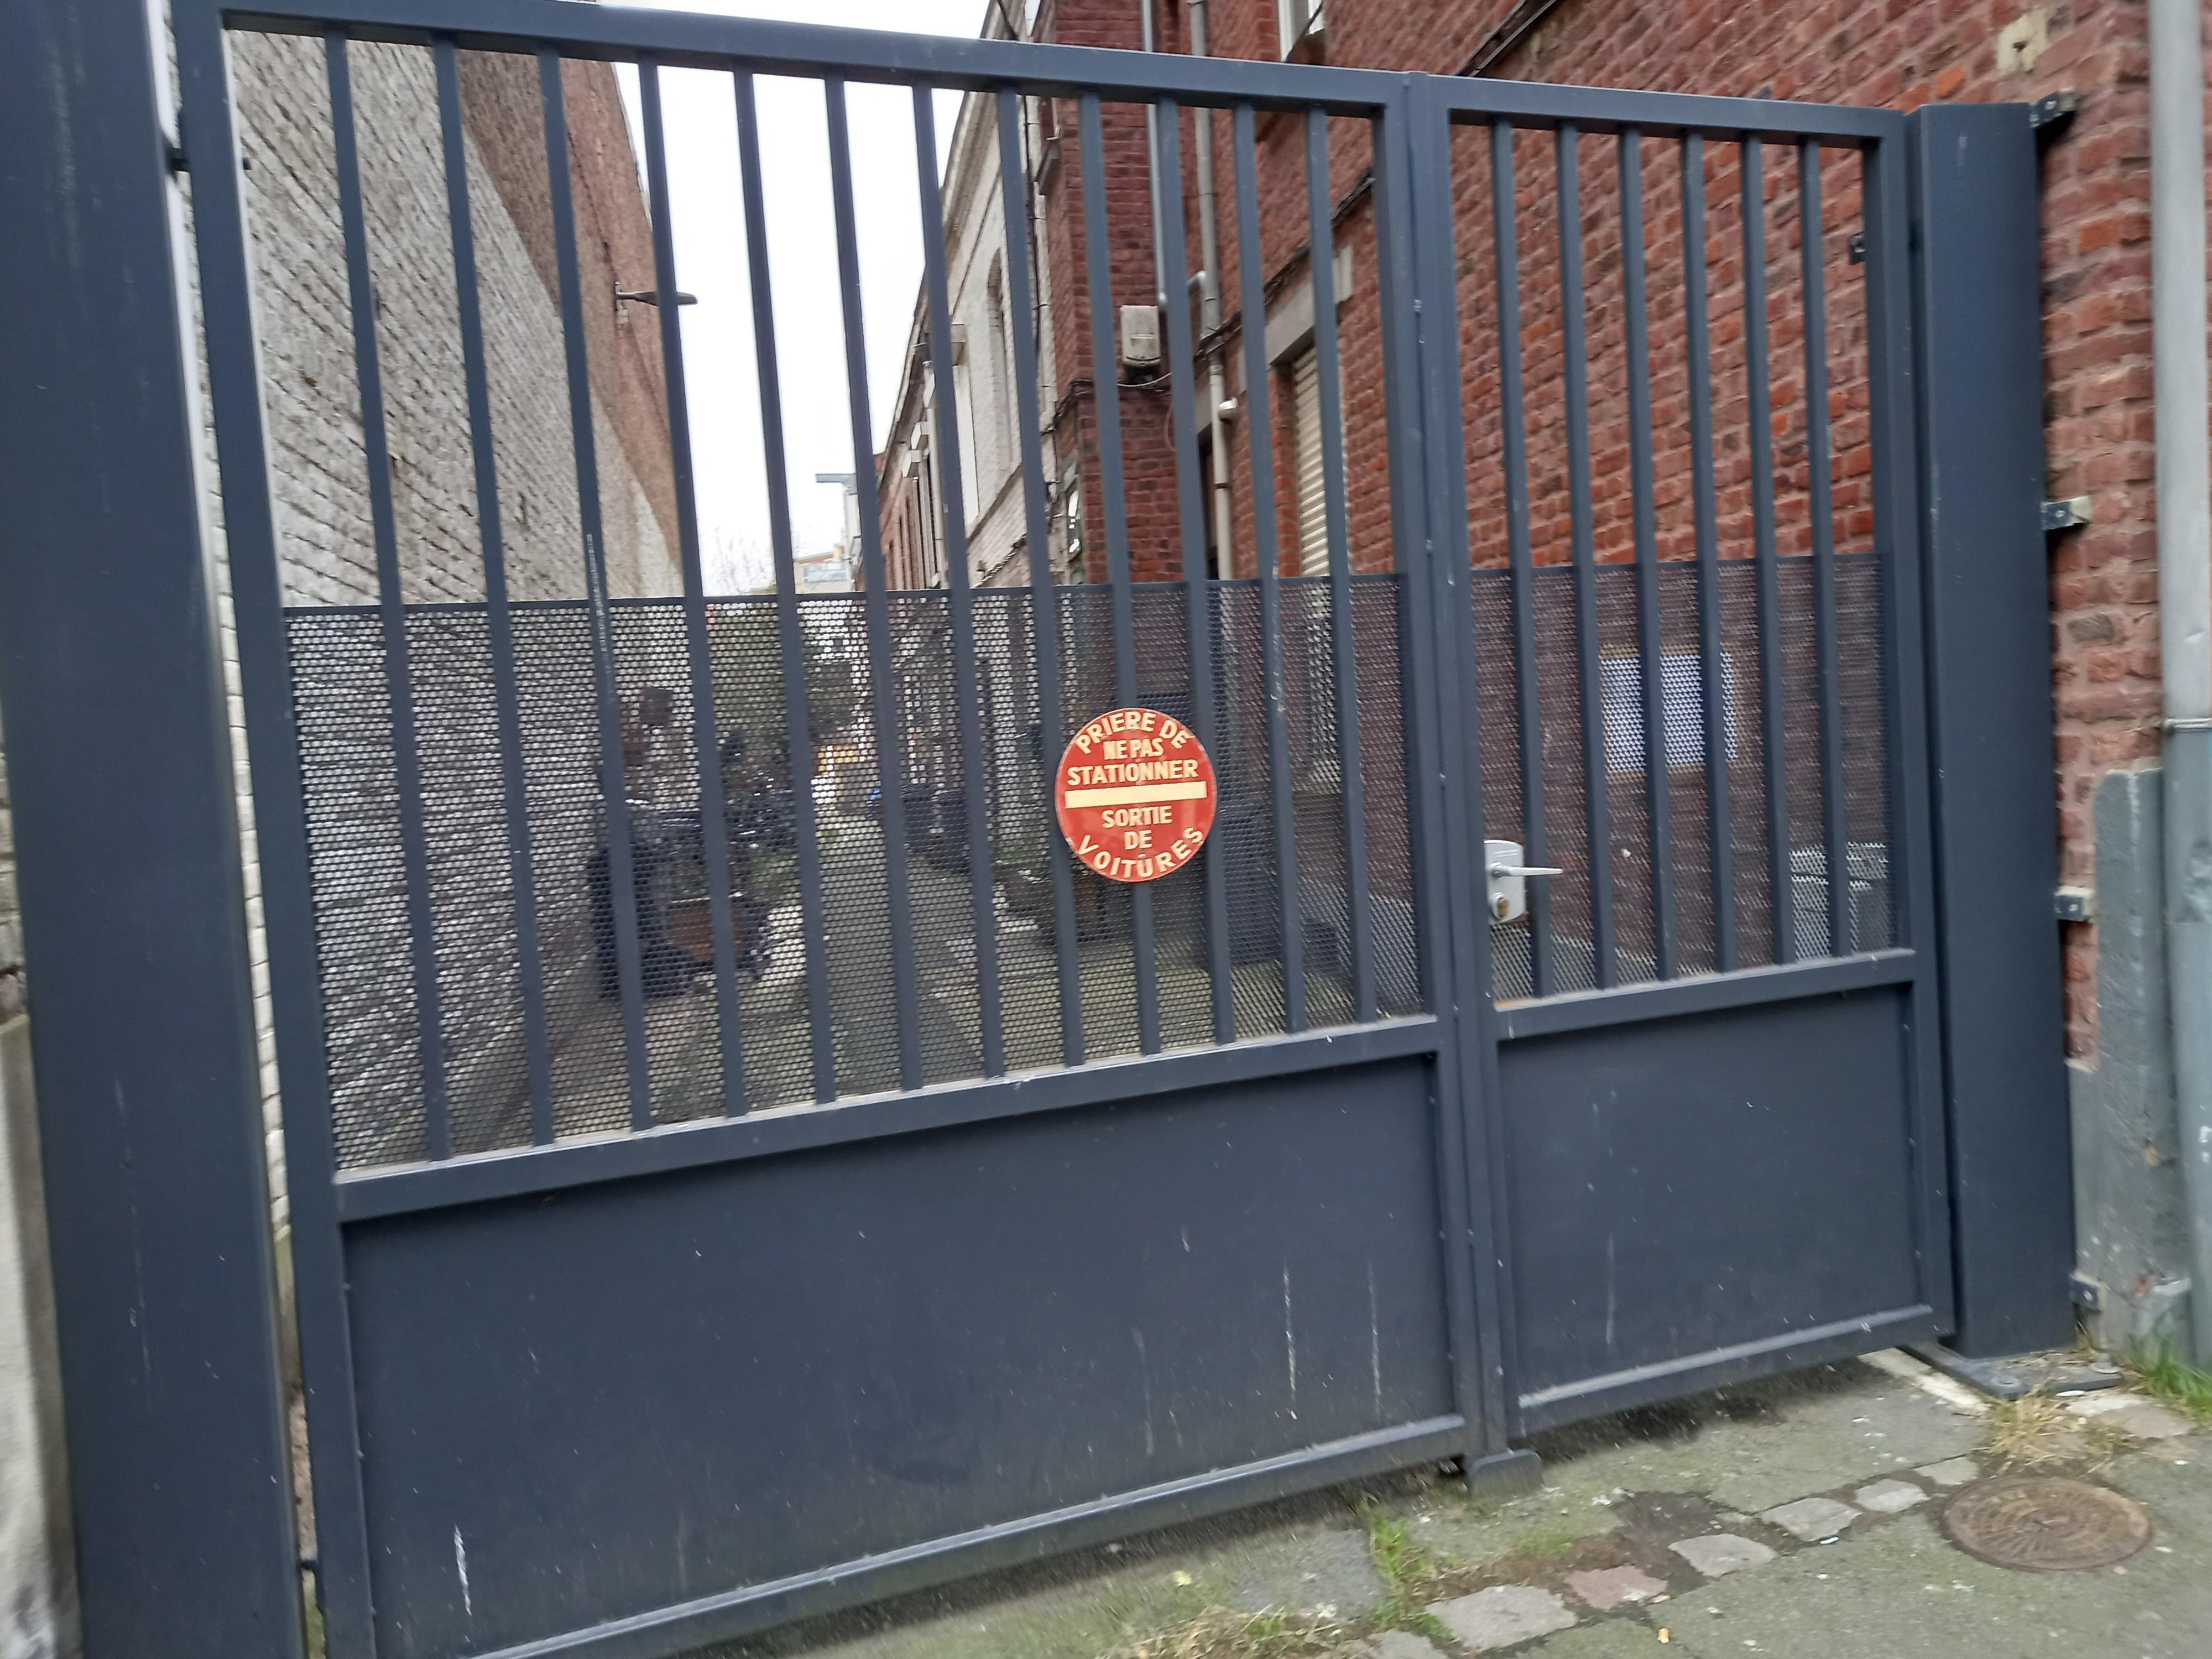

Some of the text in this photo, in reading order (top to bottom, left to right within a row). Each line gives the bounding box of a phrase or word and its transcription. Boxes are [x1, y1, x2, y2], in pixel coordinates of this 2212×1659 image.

[1075, 711, 1195, 754] PRIERE DE
[1104, 738, 1164, 760] NE PAS
[1067, 759, 1198, 786] STATIONNER
[1102, 805, 1172, 828] SORTIE
[1078, 827, 1203, 878] VOITURES
[1124, 830, 1152, 850] DE
